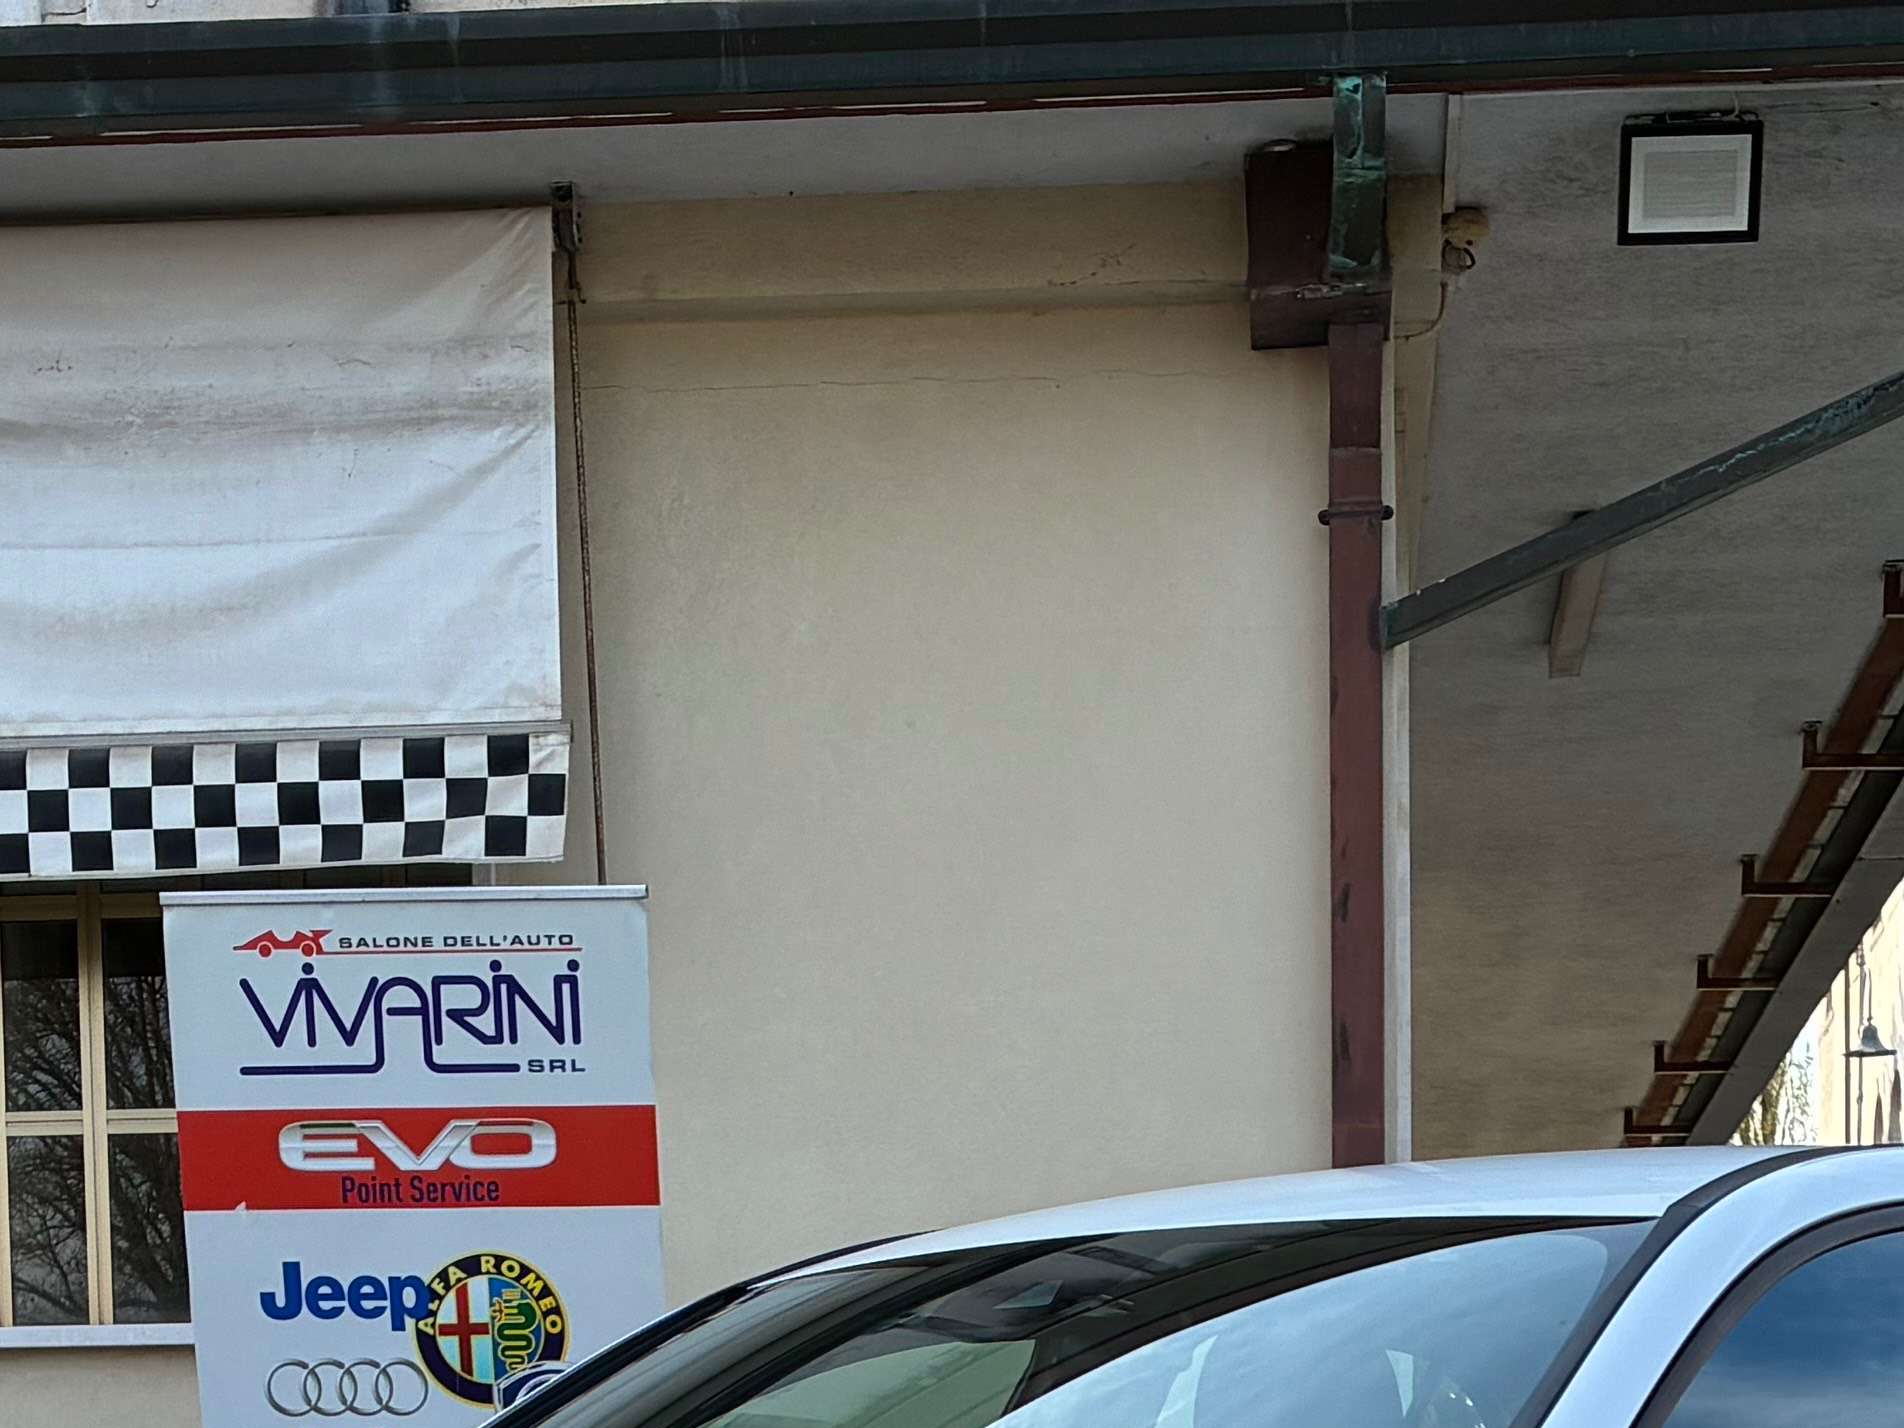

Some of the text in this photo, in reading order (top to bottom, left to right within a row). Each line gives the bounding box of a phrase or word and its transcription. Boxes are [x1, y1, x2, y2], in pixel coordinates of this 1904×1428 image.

[338, 933, 575, 950] SALONE DELL'AUTO
[527, 1058, 586, 1074] SRL
[278, 1117, 558, 1171] EVO
[340, 1174, 501, 1204] Point Service
[259, 1260, 433, 1332] Jeep
[417, 1255, 563, 1336] ALFA ROMEO
